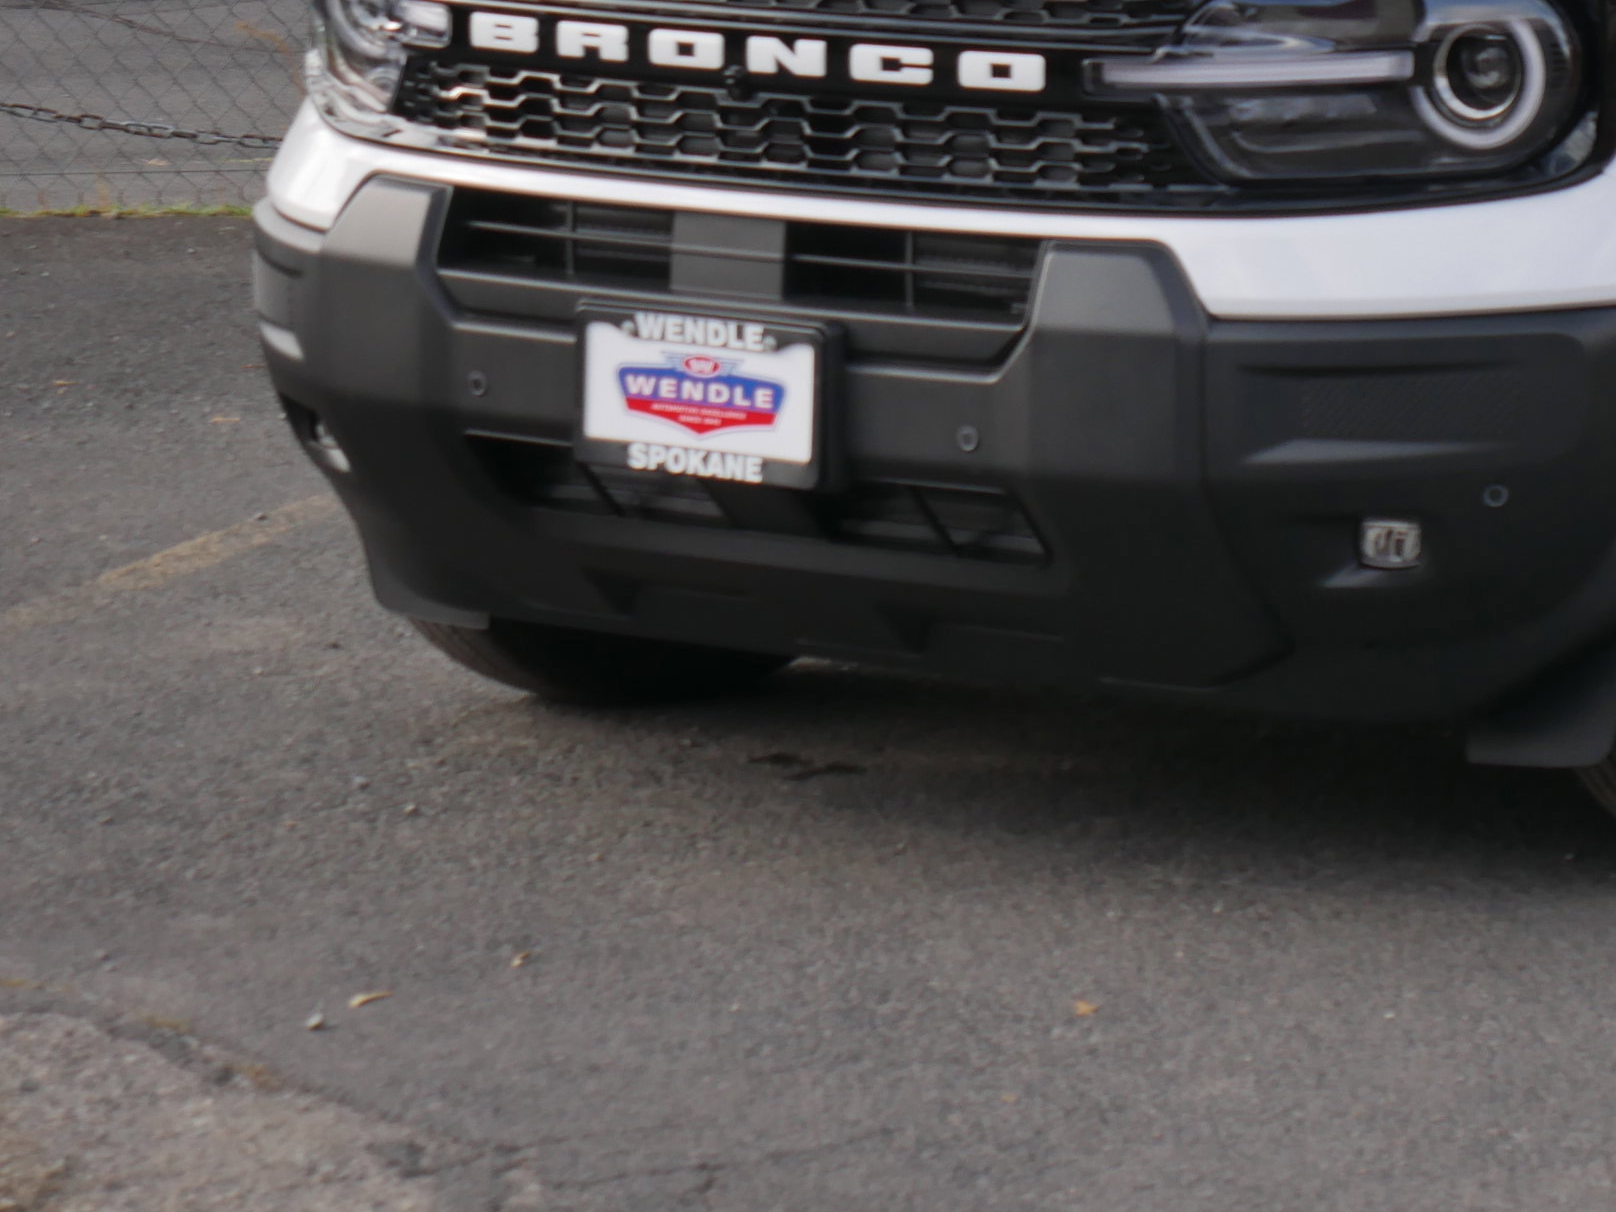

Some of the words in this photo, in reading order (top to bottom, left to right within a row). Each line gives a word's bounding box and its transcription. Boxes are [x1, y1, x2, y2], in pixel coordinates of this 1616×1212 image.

[468, 10, 1047, 92] BRONCO
[634, 310, 765, 352] WENDLE
[625, 374, 775, 409] WENDLE
[626, 442, 764, 484] SPOKANE
